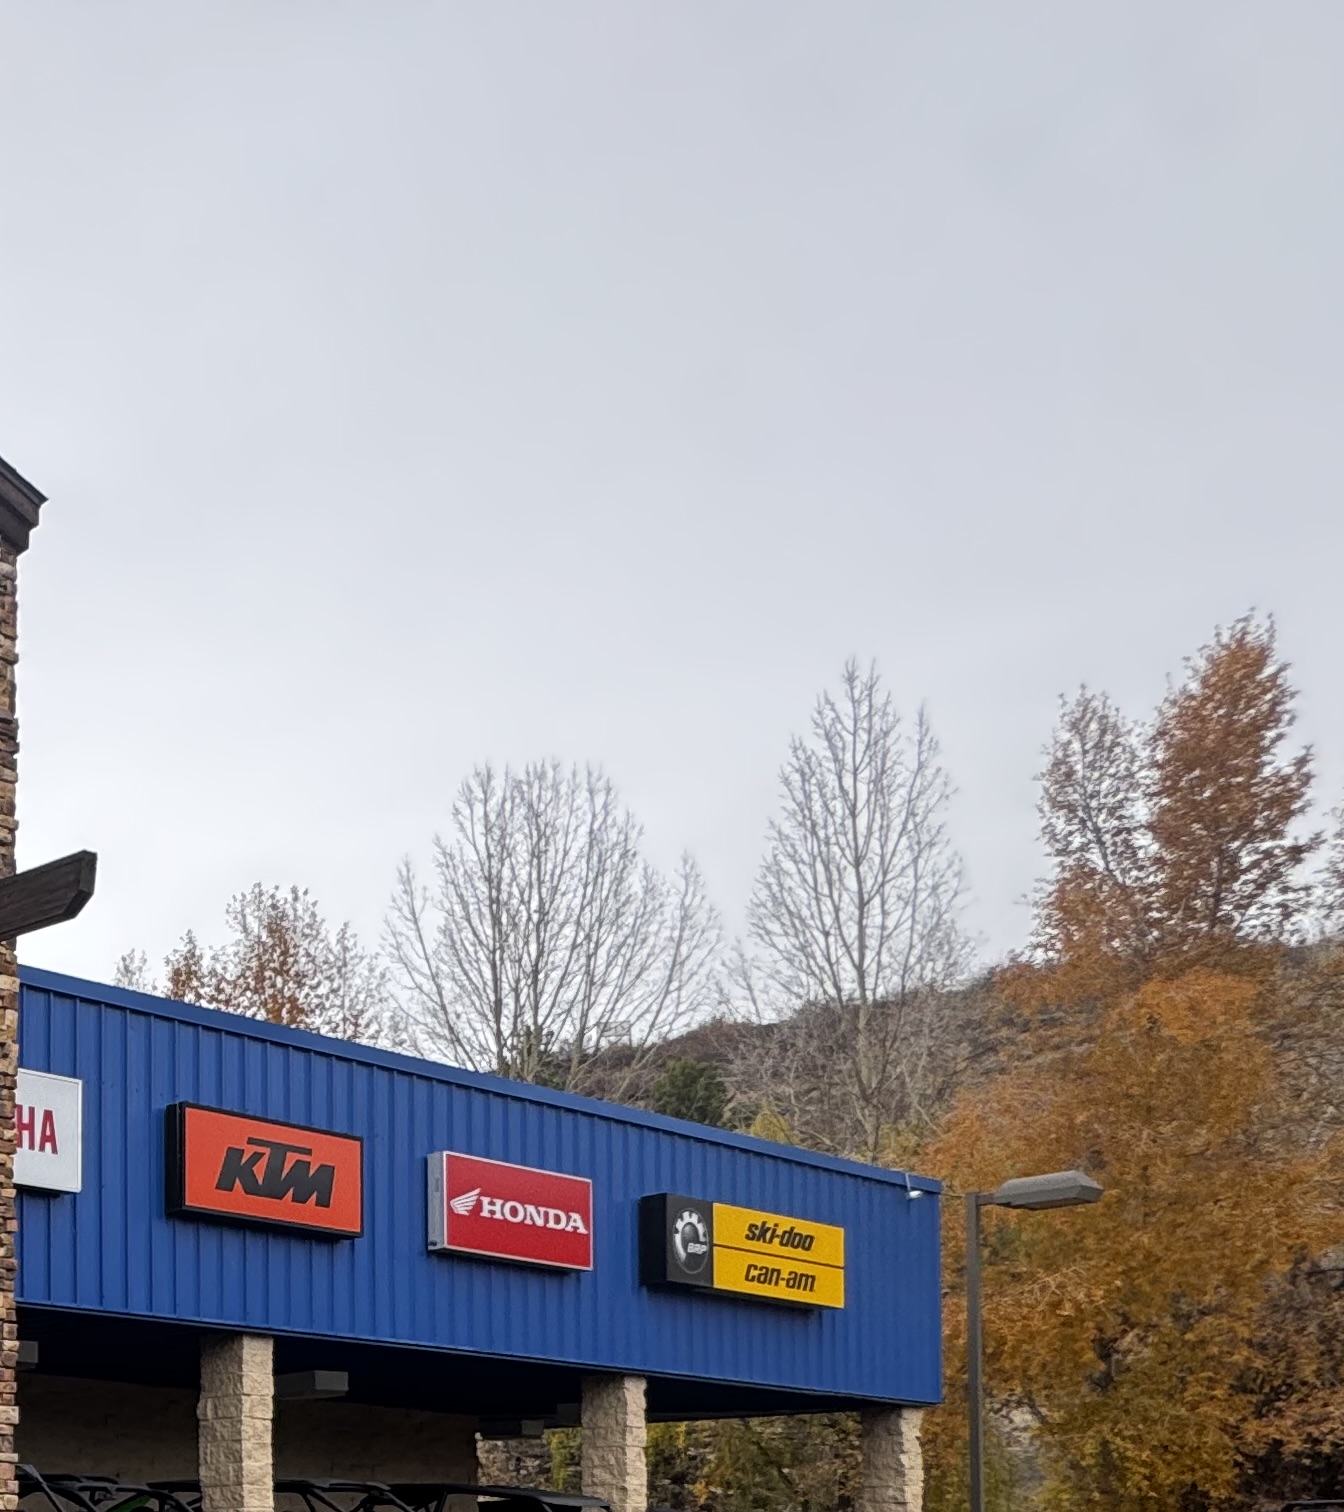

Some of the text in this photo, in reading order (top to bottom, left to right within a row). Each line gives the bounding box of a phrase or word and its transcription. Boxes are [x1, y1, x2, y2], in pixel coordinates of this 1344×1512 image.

[215, 1137, 335, 1208] KTM
[480, 1196, 589, 1234] HONDA
[744, 1220, 815, 1251] ski-doo
[744, 1263, 816, 1293] can-am
